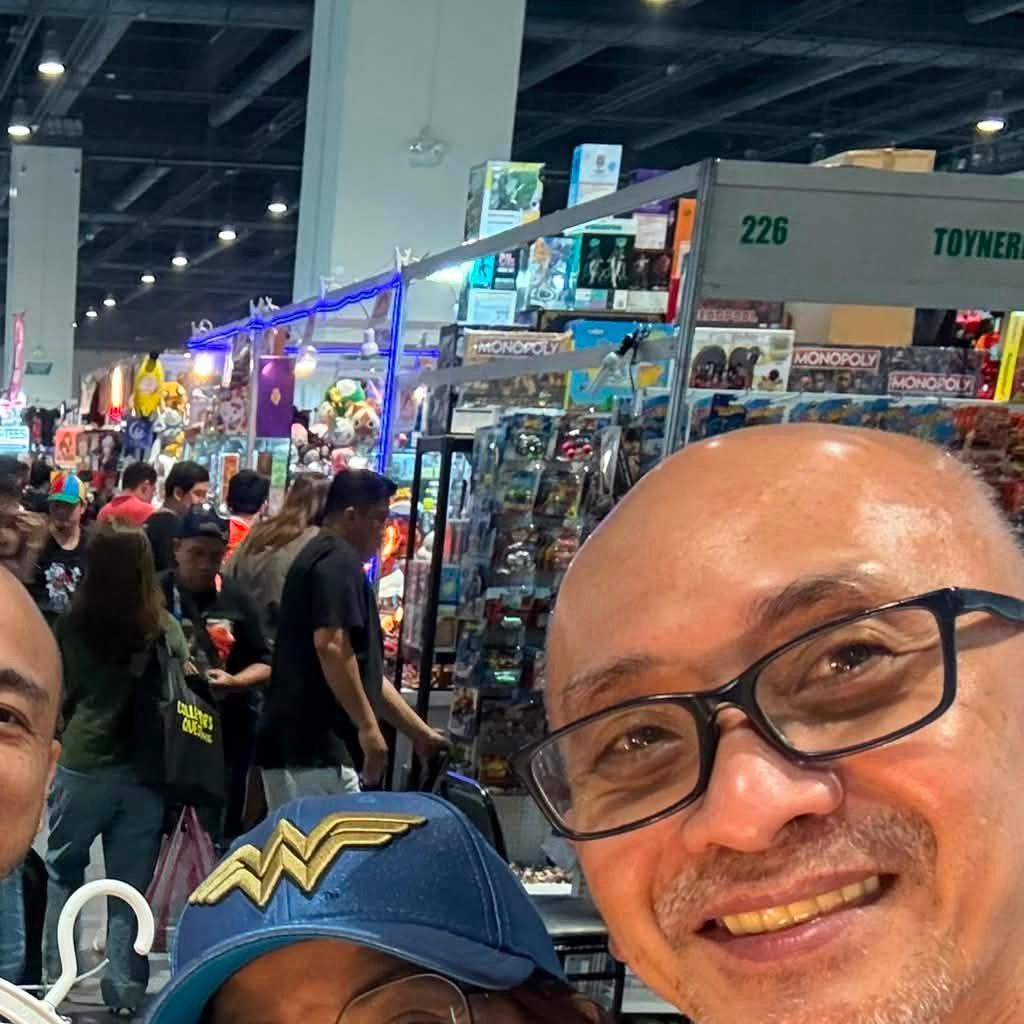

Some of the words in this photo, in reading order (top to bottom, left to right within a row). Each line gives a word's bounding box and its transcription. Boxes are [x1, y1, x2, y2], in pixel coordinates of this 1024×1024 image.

[740, 215, 789, 246] 226
[932, 227, 1024, 261] TOYNER
[475, 338, 561, 355] MONOPOLY
[792, 351, 878, 368] MONOPOLY
[890, 373, 974, 391] MONOPOLY
